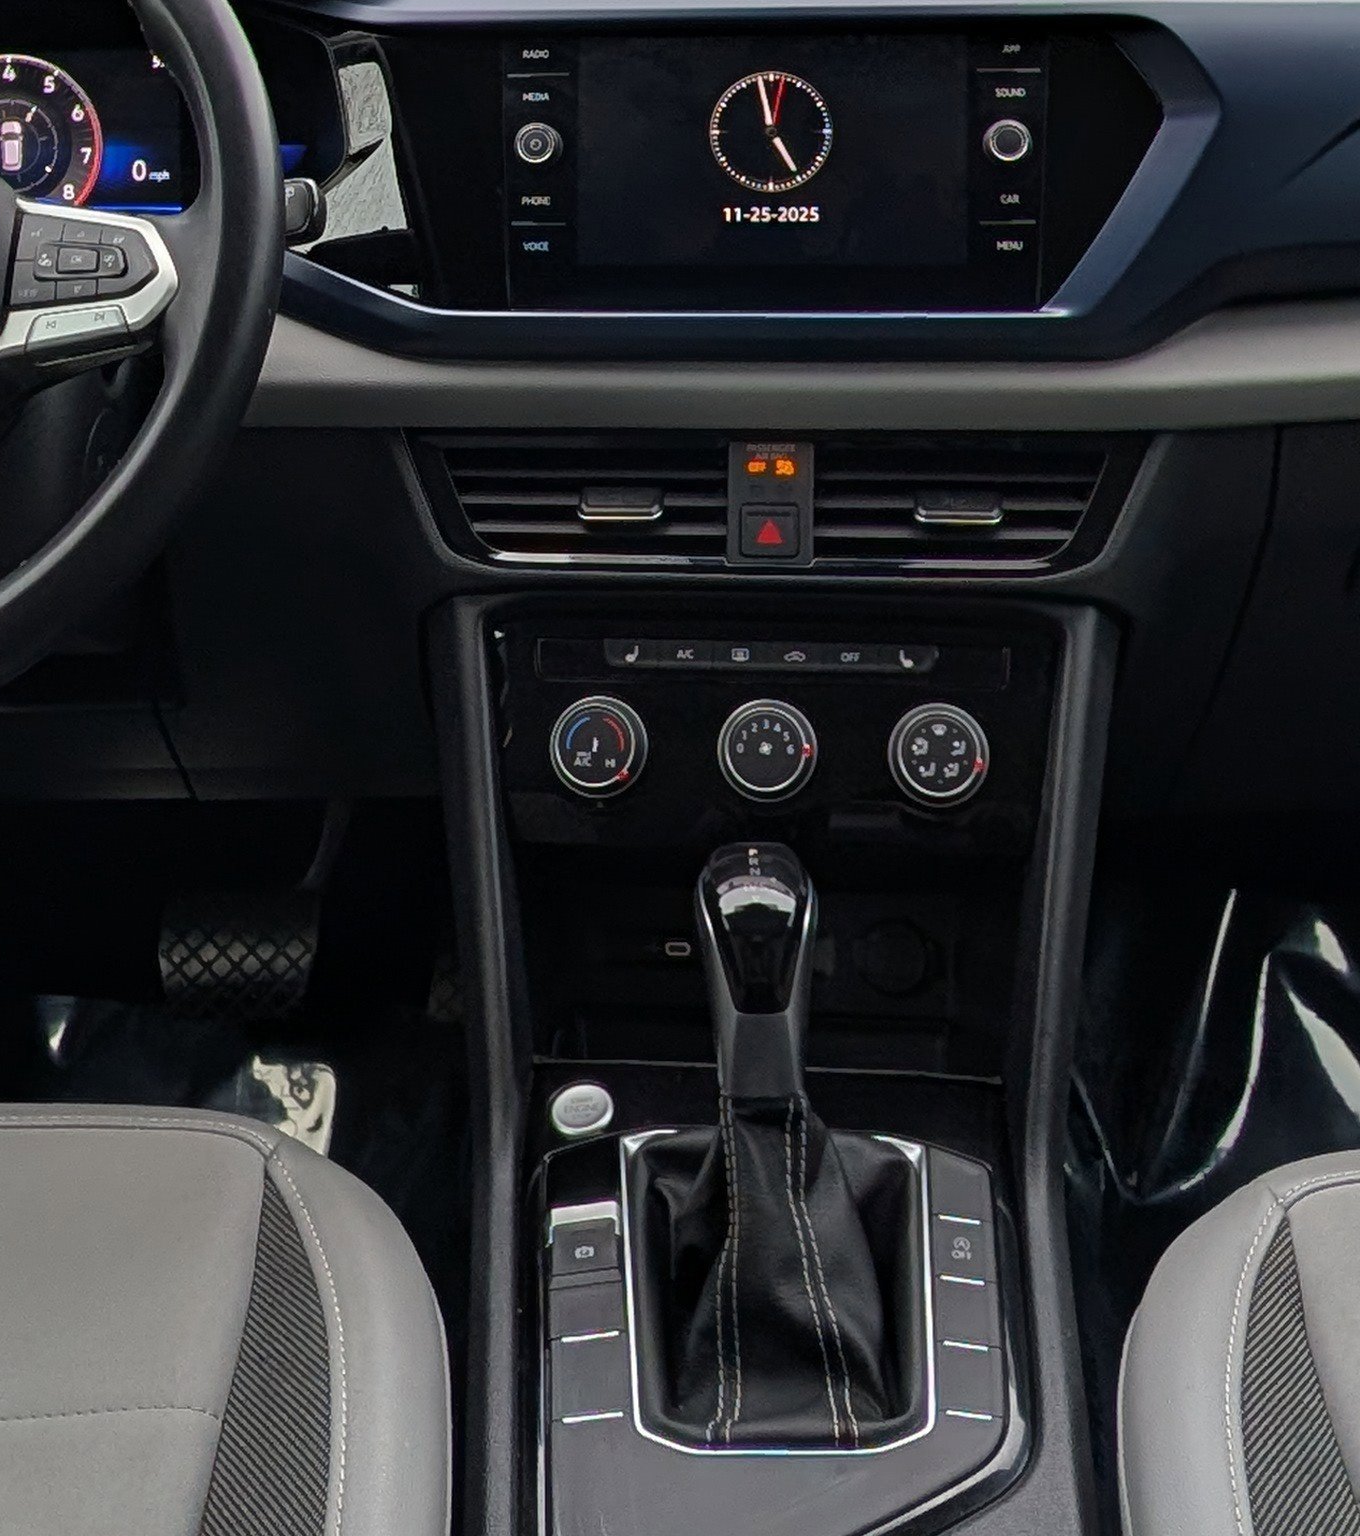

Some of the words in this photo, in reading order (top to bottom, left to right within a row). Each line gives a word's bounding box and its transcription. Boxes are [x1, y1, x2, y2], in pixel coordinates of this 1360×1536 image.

[522, 48, 550, 59] RADIO
[2, 66, 16, 82] 4
[43, 75, 56, 93] 5
[522, 91, 550, 102] MEDIA
[994, 87, 1026, 98] SOUND
[71, 105, 84, 122] 6
[81, 147, 92, 164] 7
[132, 159, 147, 182] 0
[62, 183, 75, 200] 8
[521, 195, 551, 206] PHONE
[1000, 194, 1021, 204] CAR
[722, 206, 820, 223] 11-25-2025
[522, 241, 549, 253] VOICE
[996, 240, 1024, 251] MENU
[676, 648, 695, 660] A/C
[840, 651, 861, 663] OFF
[751, 722, 759, 733] 2
[762, 718, 770, 730] 3
[772, 722, 782, 733] 4
[741, 730, 748, 741] 1
[783, 730, 791, 742] 5
[736, 742, 745, 754] 0
[786, 744, 796, 755] 6
